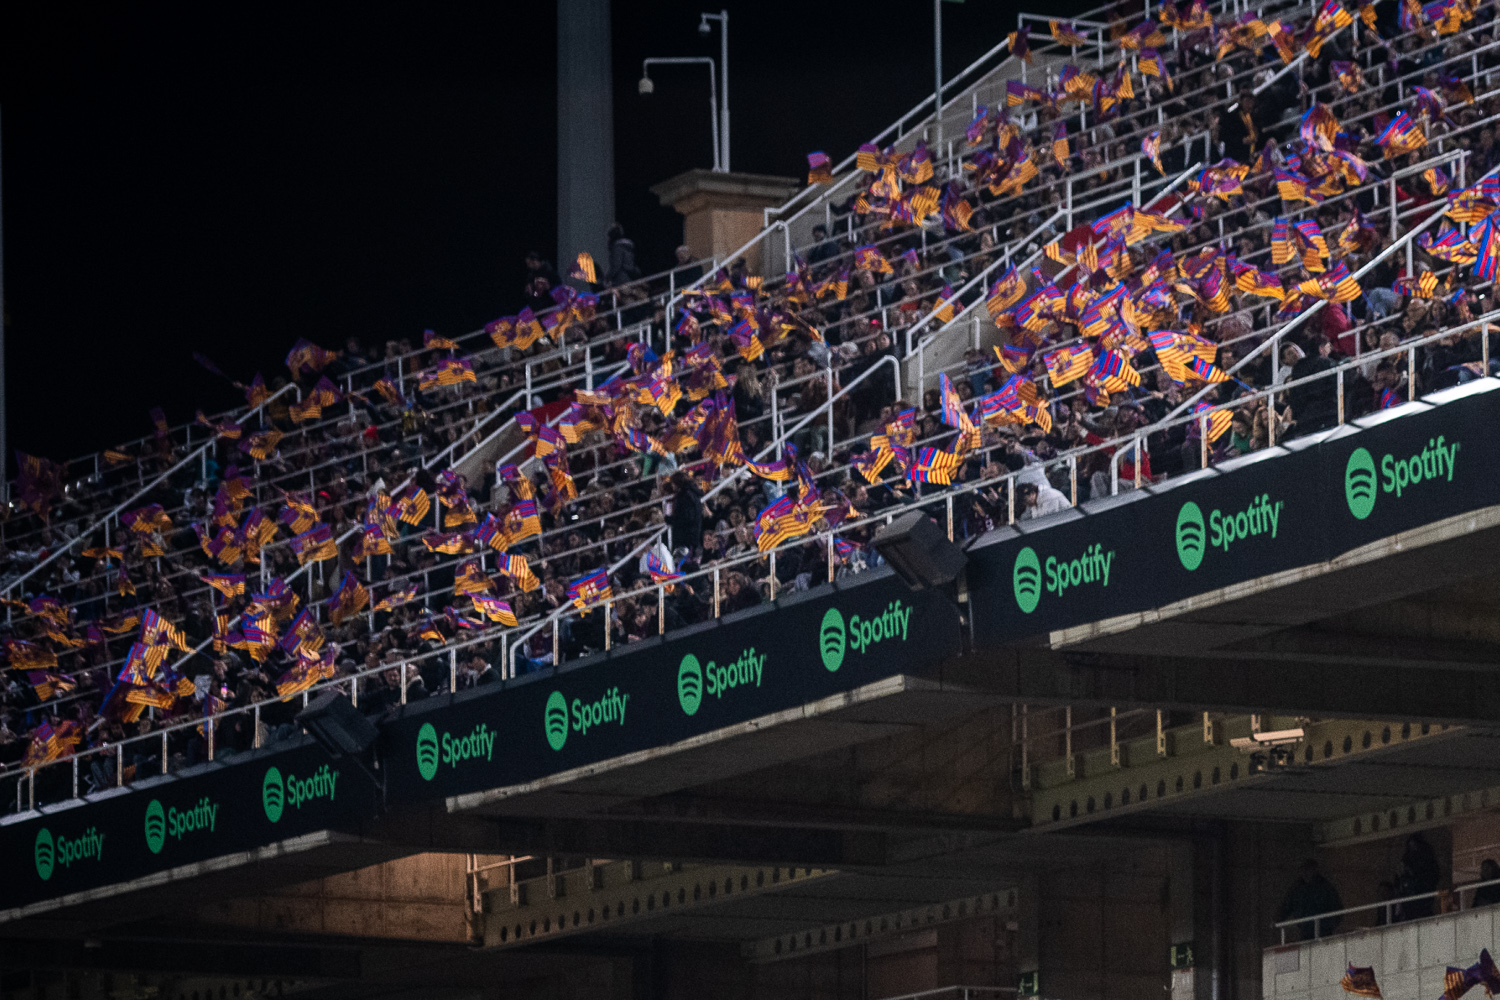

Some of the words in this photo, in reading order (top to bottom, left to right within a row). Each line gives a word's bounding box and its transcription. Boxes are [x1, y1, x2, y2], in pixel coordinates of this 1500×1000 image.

[1380, 434, 1461, 498] Spotify
[1209, 493, 1284, 552] Spotify
[1045, 543, 1115, 597] Spotify
[849, 599, 913, 654] Spotify
[705, 647, 767, 699] Spotify
[571, 686, 629, 736] Spotify
[441, 723, 495, 769] Spotify
[286, 764, 339, 809] Spotify
[168, 796, 217, 841] Spotify
[57, 826, 103, 868] Spotify
